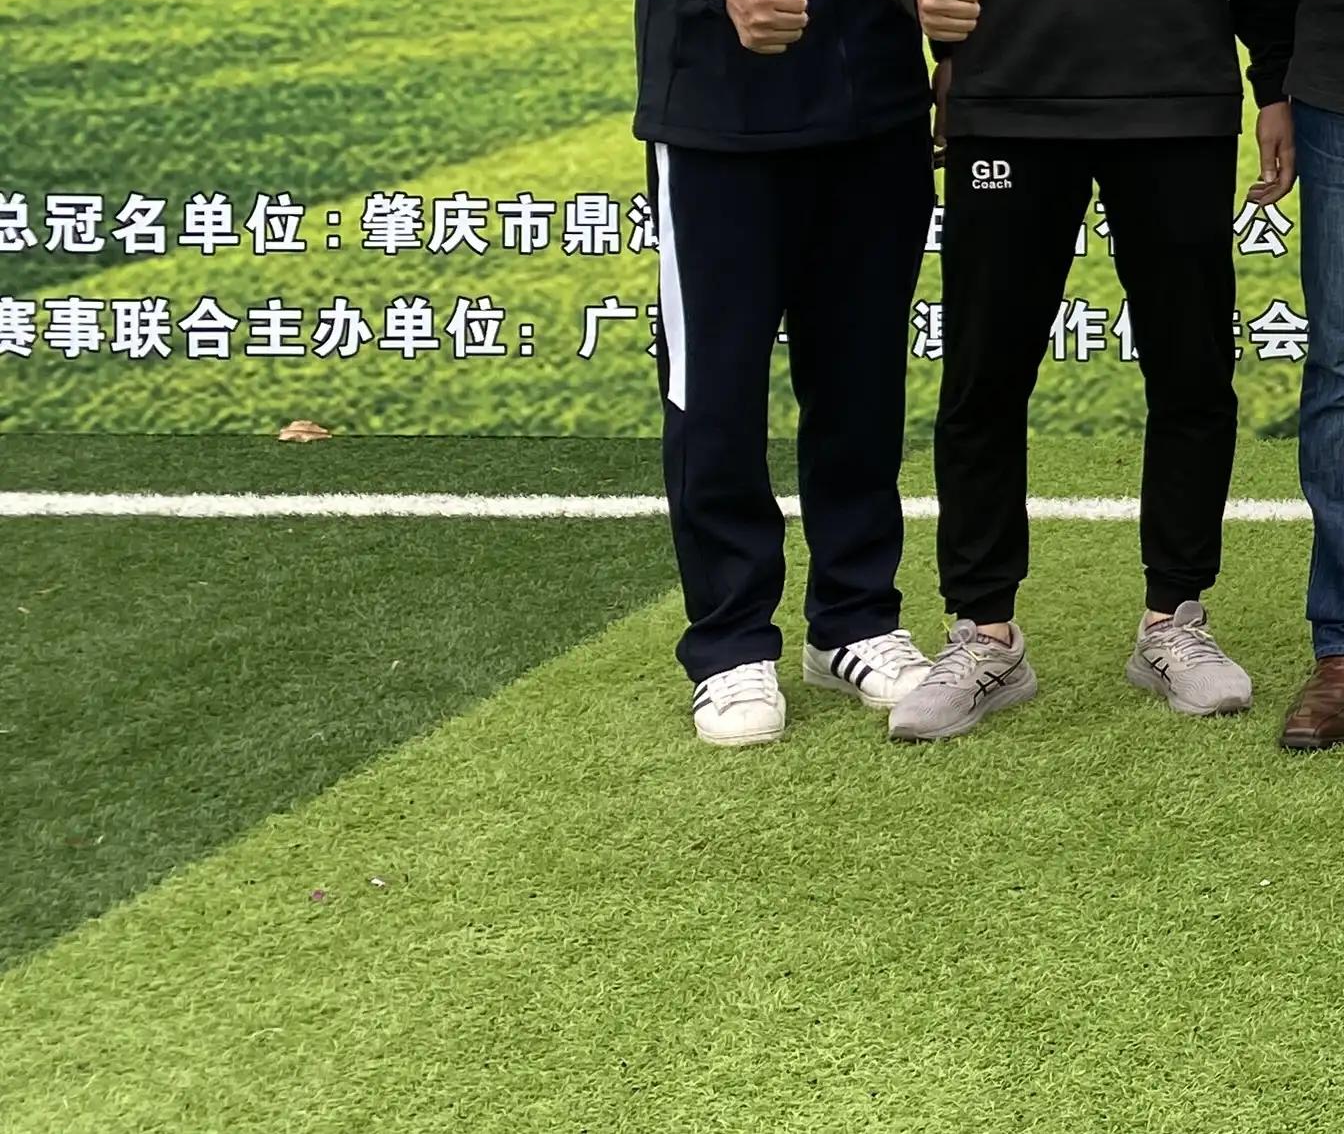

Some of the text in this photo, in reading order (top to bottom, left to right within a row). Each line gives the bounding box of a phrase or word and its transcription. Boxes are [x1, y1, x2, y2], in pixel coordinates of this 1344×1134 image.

[971, 160, 1011, 179] GD
[971, 178, 1013, 189] Coach
[0, 295, 660, 361] 赛事联合主办单位：广
